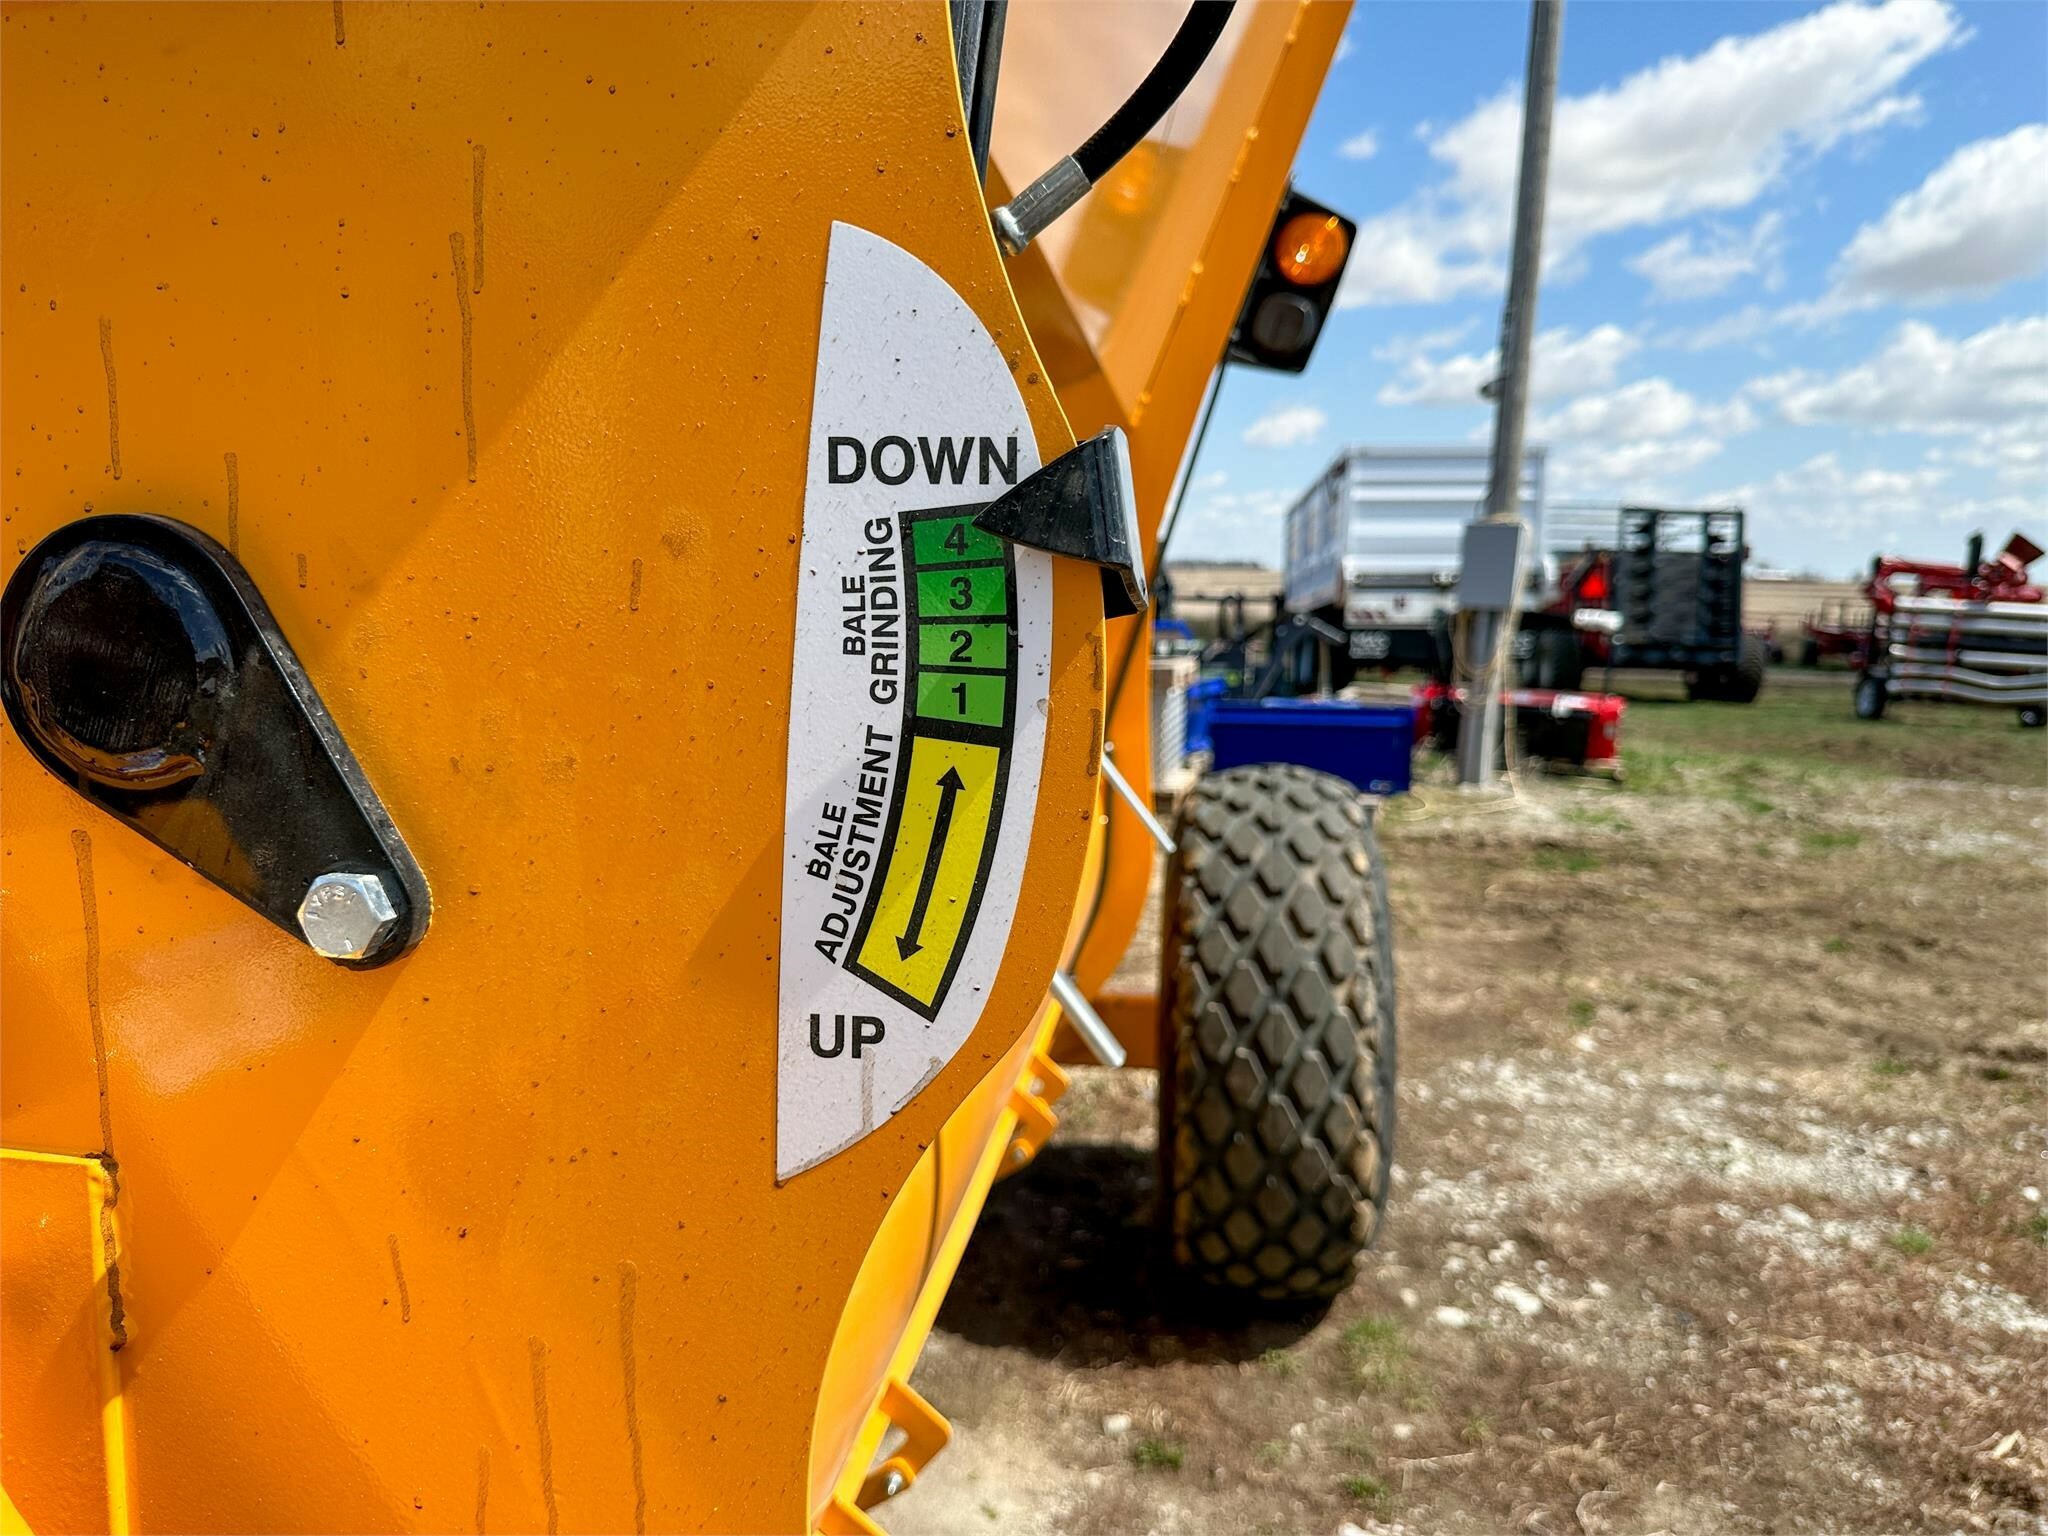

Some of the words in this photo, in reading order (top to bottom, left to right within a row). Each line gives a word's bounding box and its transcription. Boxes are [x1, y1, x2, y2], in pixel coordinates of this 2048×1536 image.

[828, 436, 1018, 485] DOWN
[943, 523, 969, 556] 4
[842, 575, 866, 655] BALE
[864, 517, 899, 704] GRINDING
[949, 577, 973, 610] 3
[950, 630, 973, 663] 2
[951, 682, 967, 715] 1
[808, 802, 846, 881] BALE
[814, 725, 893, 964] ADJUSTMENT
[809, 1013, 886, 1059] UP
